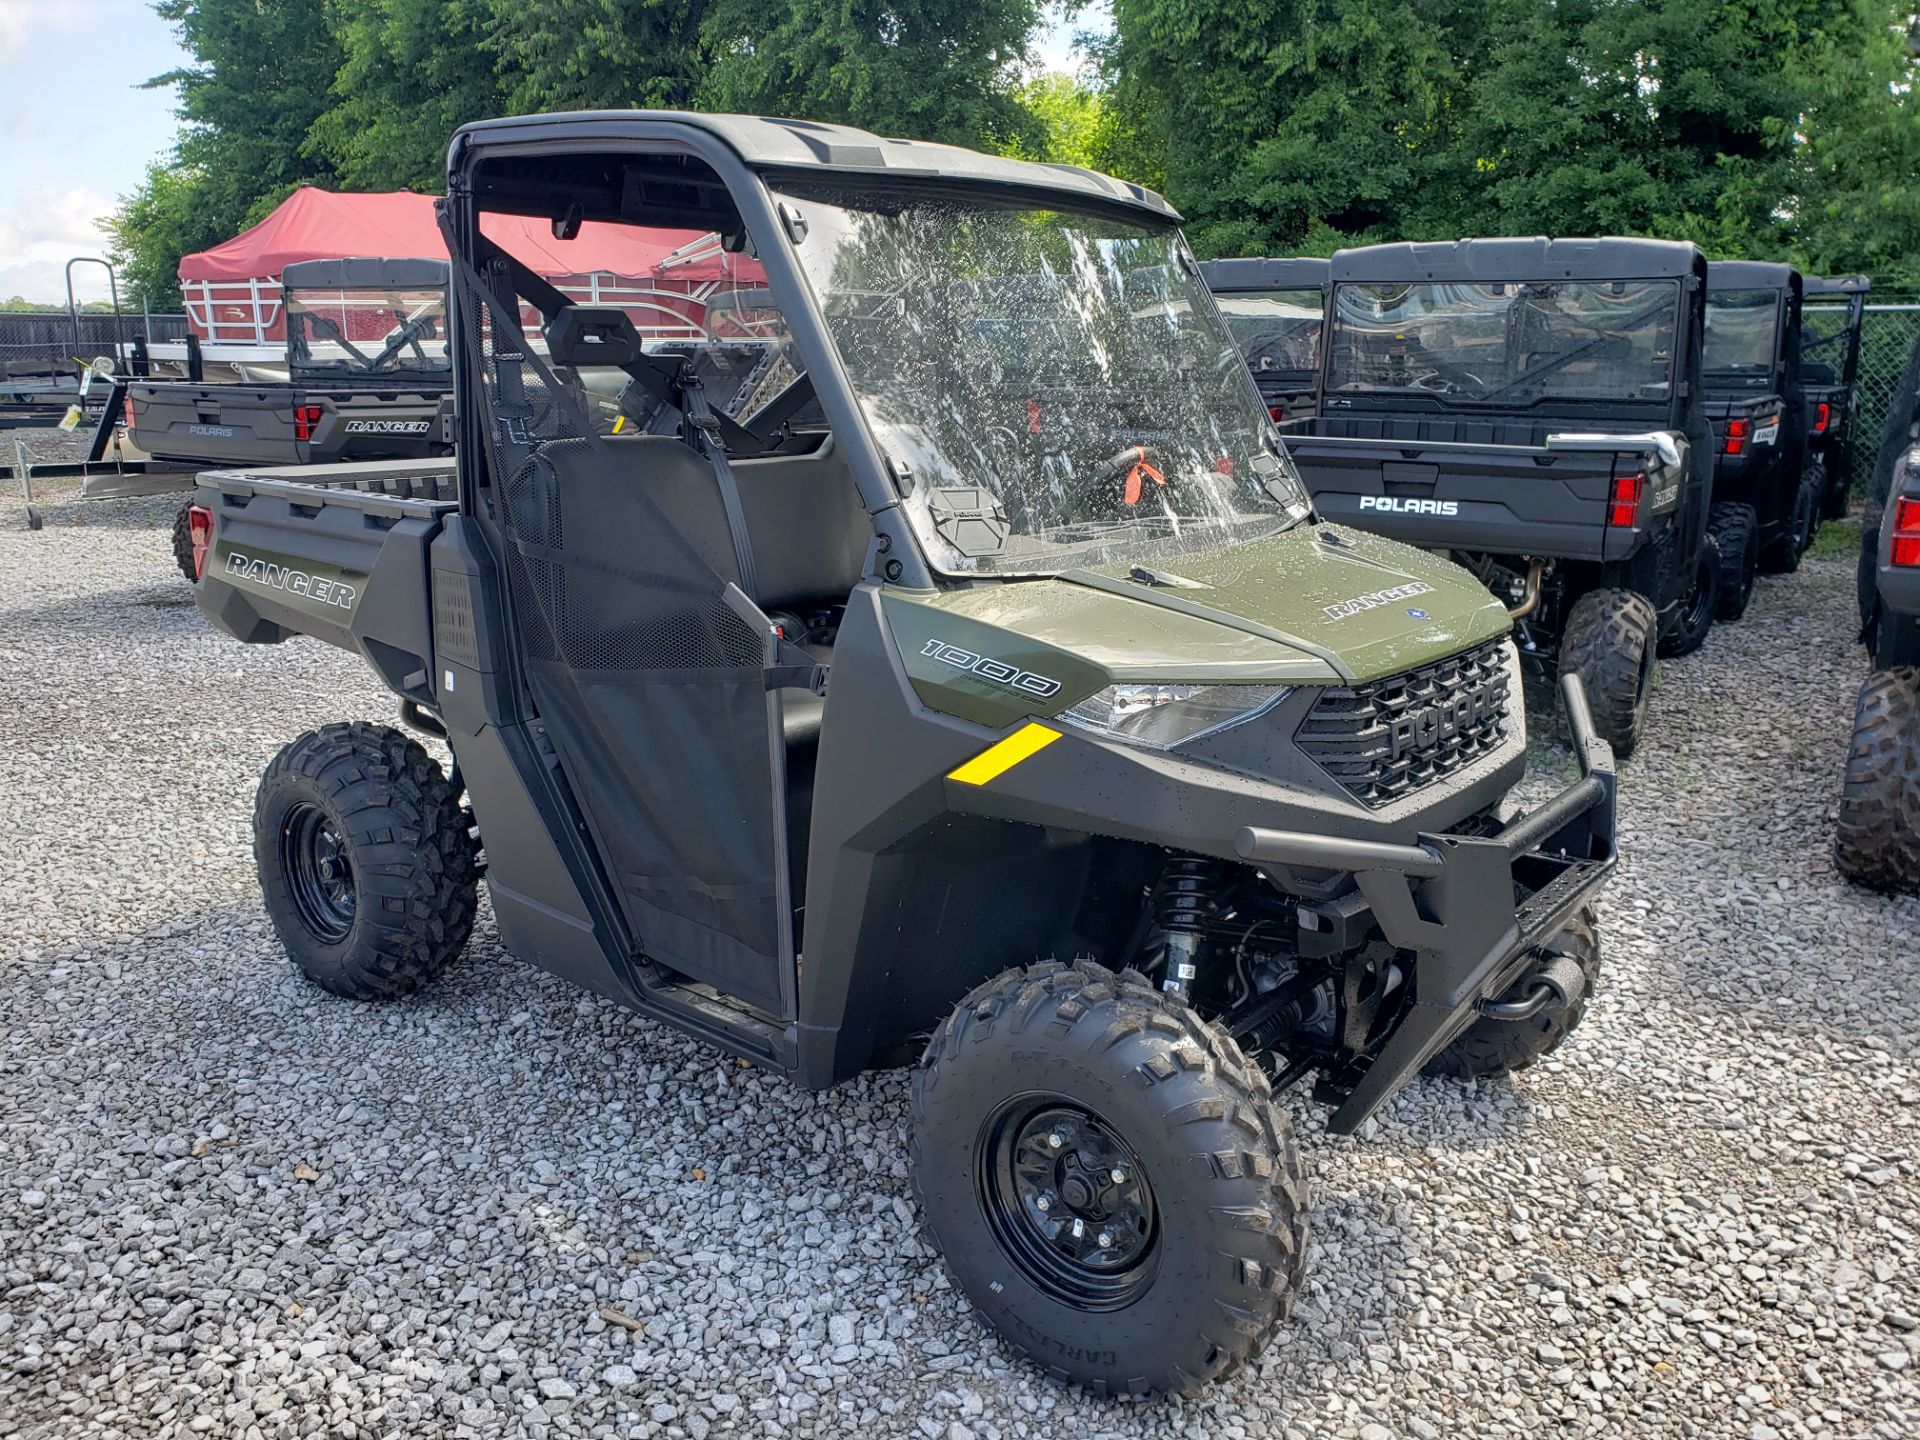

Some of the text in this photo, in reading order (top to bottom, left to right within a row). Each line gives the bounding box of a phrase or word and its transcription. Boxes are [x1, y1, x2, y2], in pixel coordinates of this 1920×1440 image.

[189, 425, 233, 437] POLARIS
[345, 421, 430, 433] RANGER
[1359, 495, 1458, 516] POLARIS
[225, 552, 356, 609] RANGER
[1322, 581, 1437, 620] RANGER
[920, 638, 1062, 698] 1000
[959, 674, 1020, 698] OVERHEAD
[1020, 695, 1048, 707] CAM
[1391, 670, 1511, 760] POLARIS
